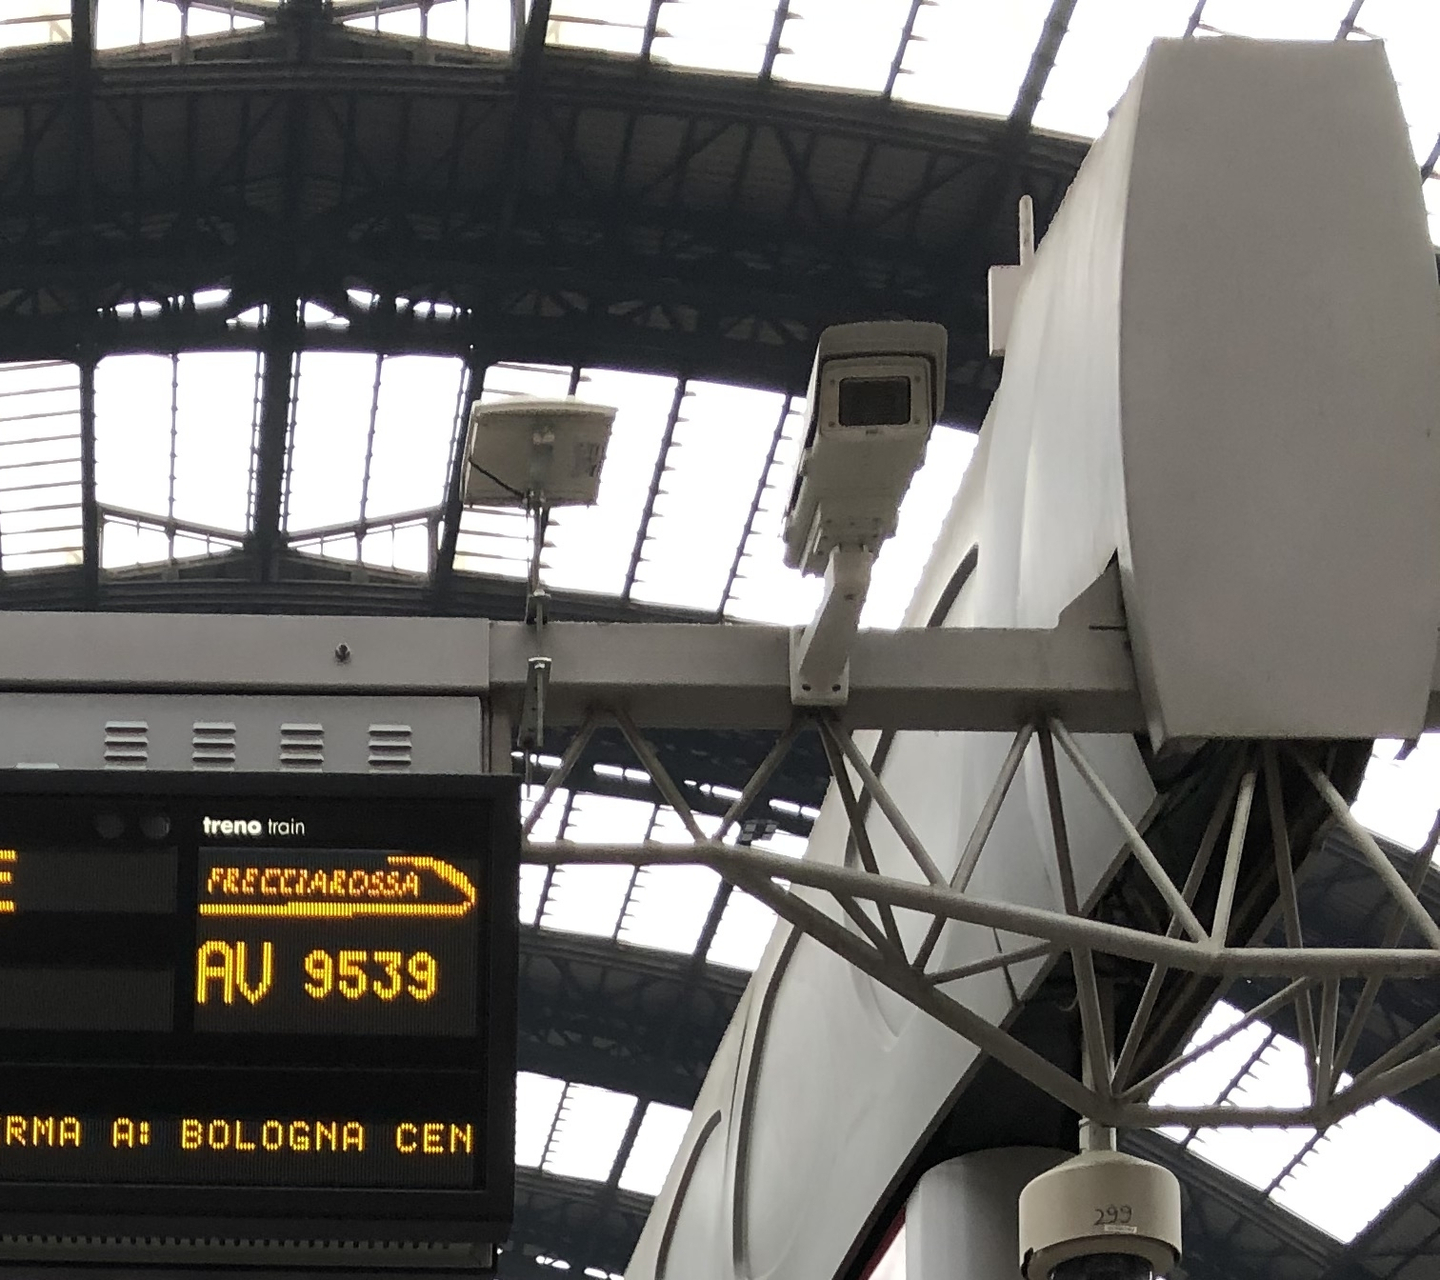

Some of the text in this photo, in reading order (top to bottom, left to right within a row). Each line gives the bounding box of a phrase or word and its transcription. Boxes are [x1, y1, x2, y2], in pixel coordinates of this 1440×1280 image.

[203, 816, 305, 836] treno train
[208, 867, 419, 897] FRECCIAROSSA
[197, 940, 438, 1005] AV 9539
[112, 1117, 151, 1148] A:
[181, 1119, 365, 1152] BOLOGNA
[396, 1122, 473, 1154] CEN
[1093, 1204, 1132, 1226] 299
